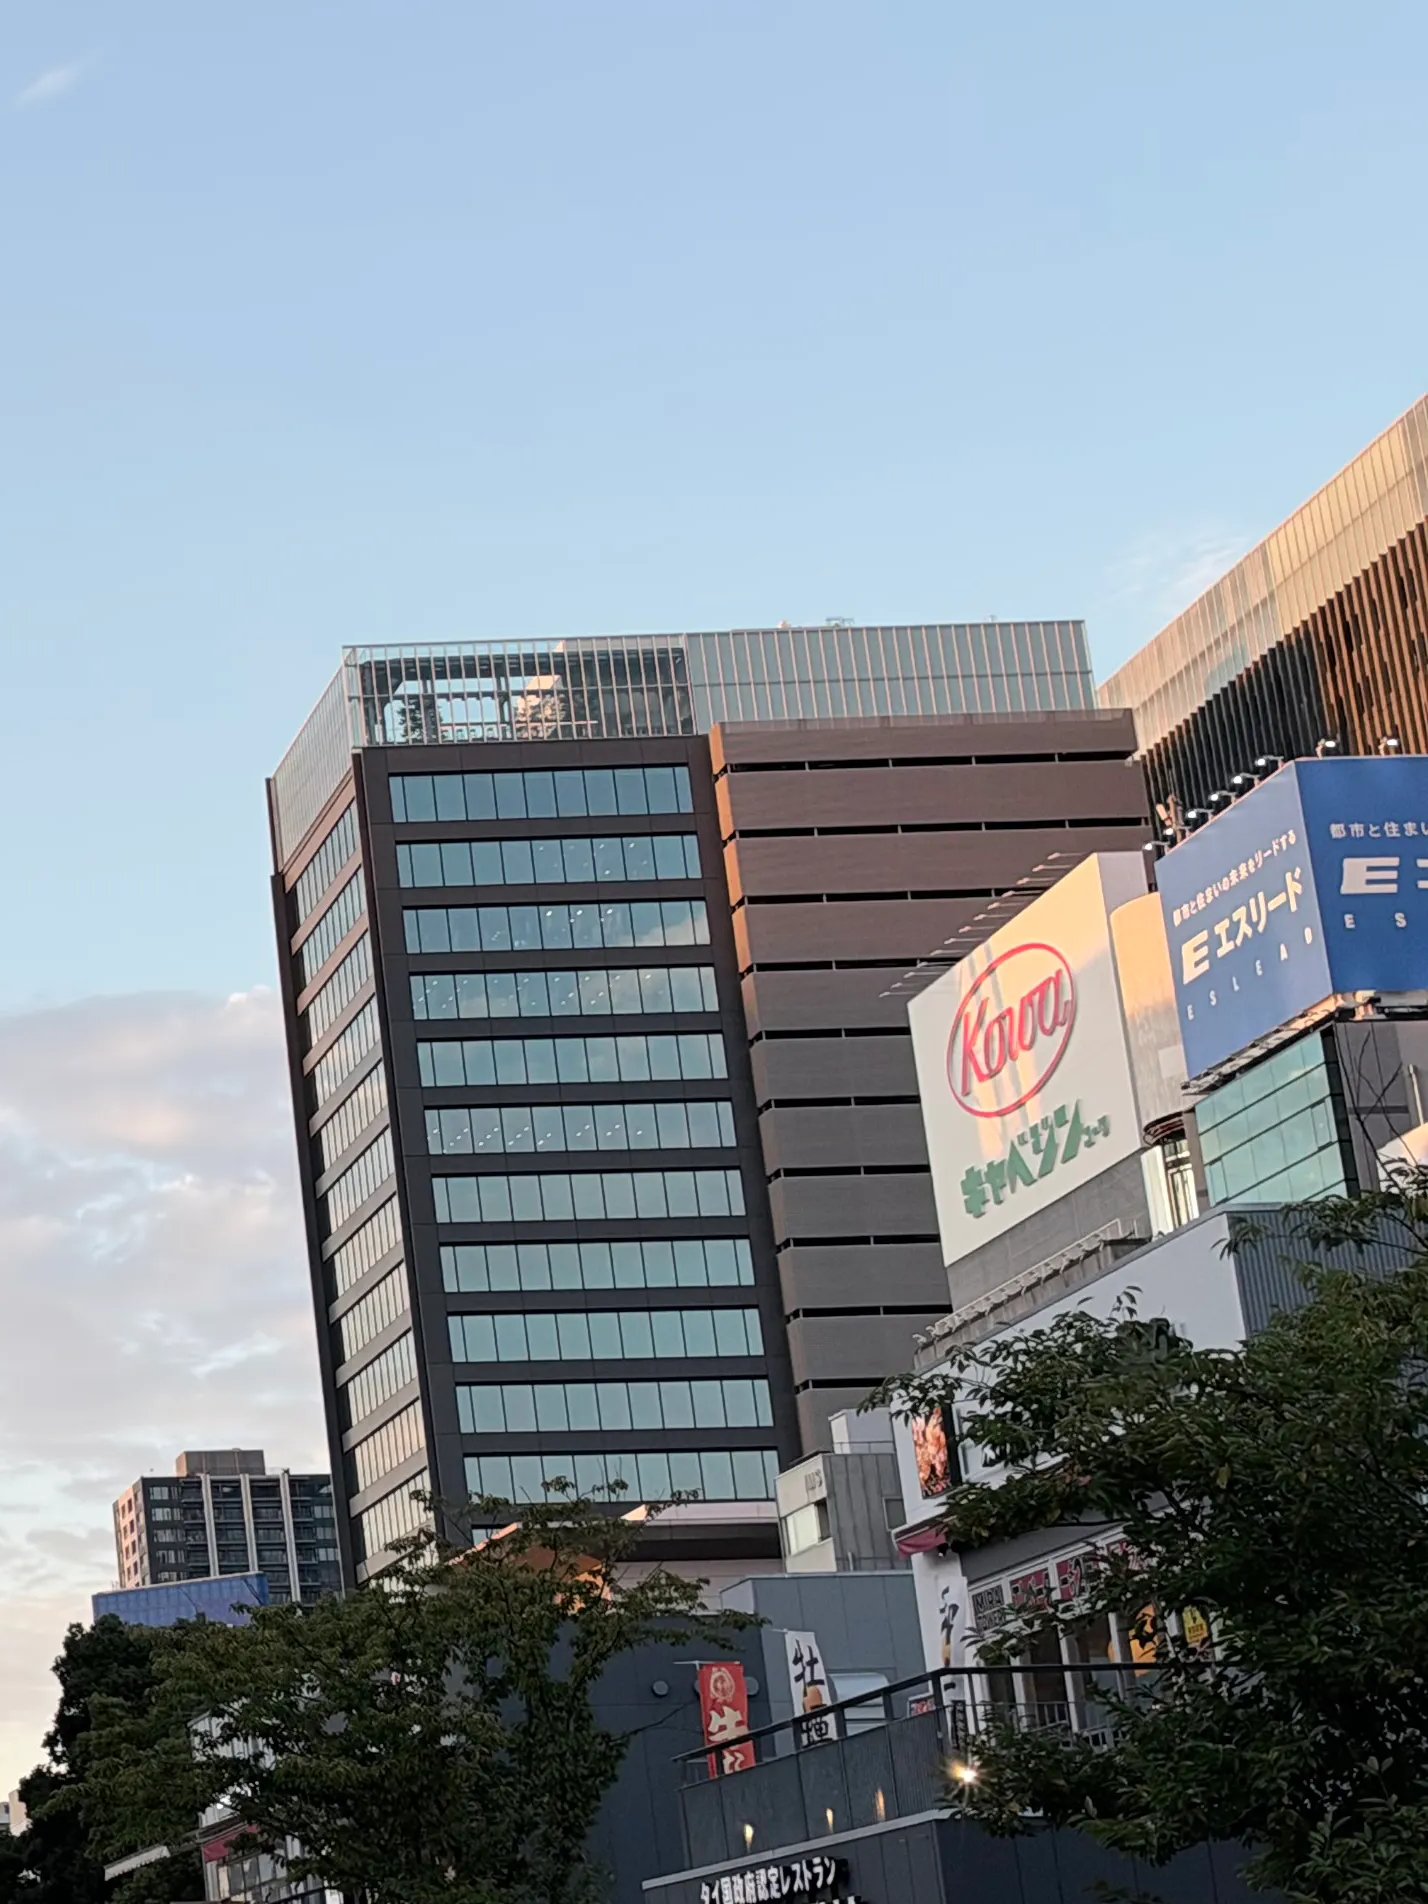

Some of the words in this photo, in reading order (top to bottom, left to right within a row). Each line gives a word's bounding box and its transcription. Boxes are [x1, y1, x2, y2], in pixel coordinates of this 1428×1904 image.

[1214, 866, 1303, 959] エスリード
[961, 968, 1072, 1096] Kowa
